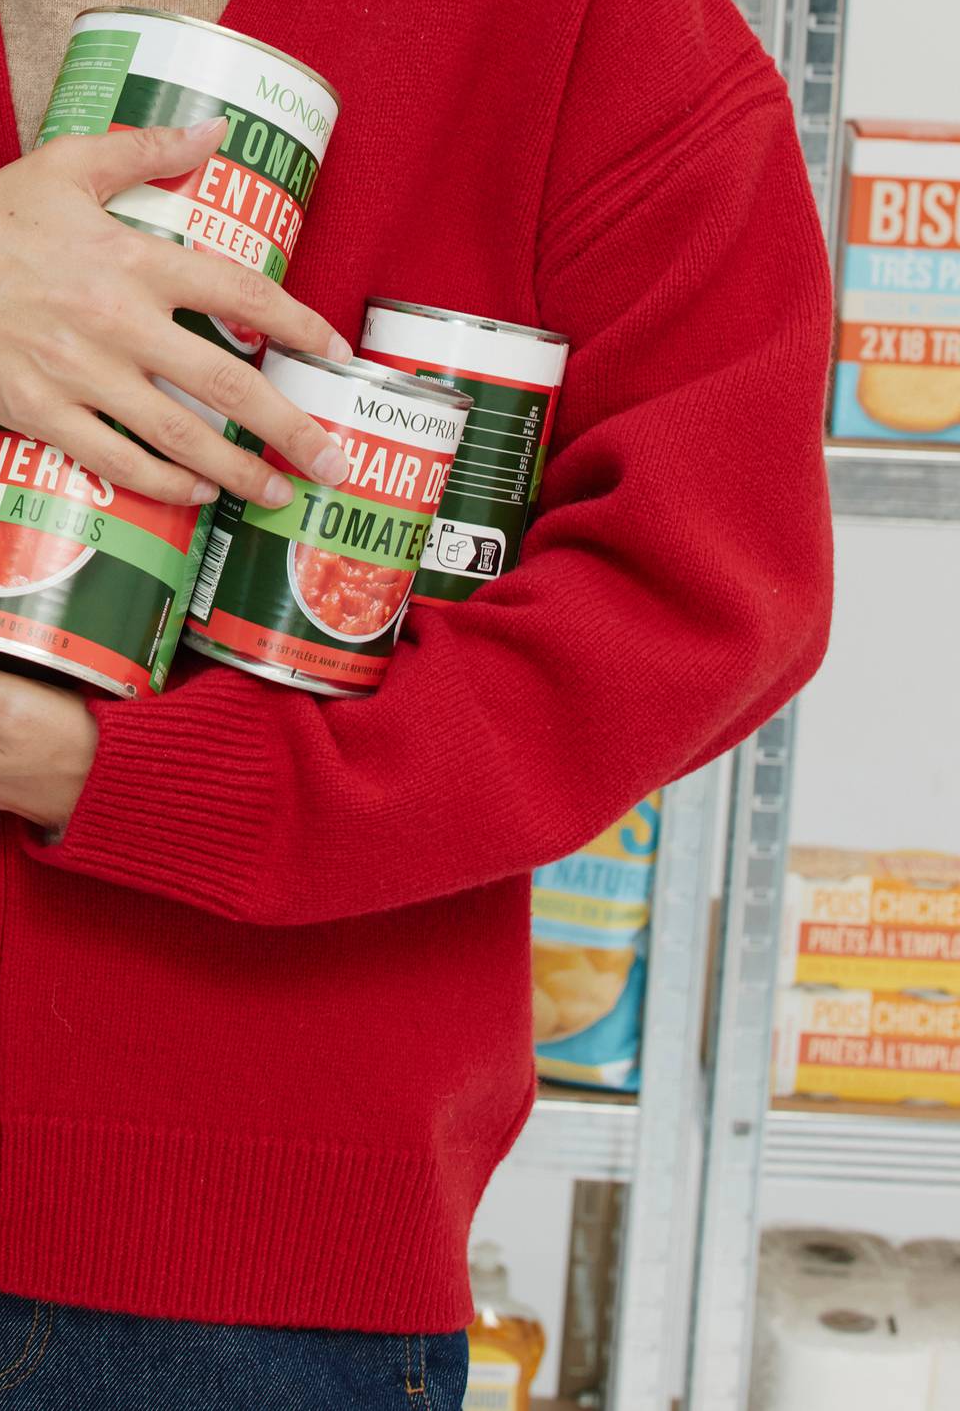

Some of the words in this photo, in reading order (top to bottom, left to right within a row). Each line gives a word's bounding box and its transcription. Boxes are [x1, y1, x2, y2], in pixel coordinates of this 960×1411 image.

[187, 208, 262, 265] PELÉES
[869, 180, 960, 246] BIS
[353, 396, 460, 441] MONOPRIX
[328, 432, 421, 503] HAIR
[422, 460, 451, 505] DE
[10, 494, 45, 522] AU
[56, 509, 105, 542] JUS
[62, 637, 71, 649] B
[319, 656, 341, 670] AVANT
